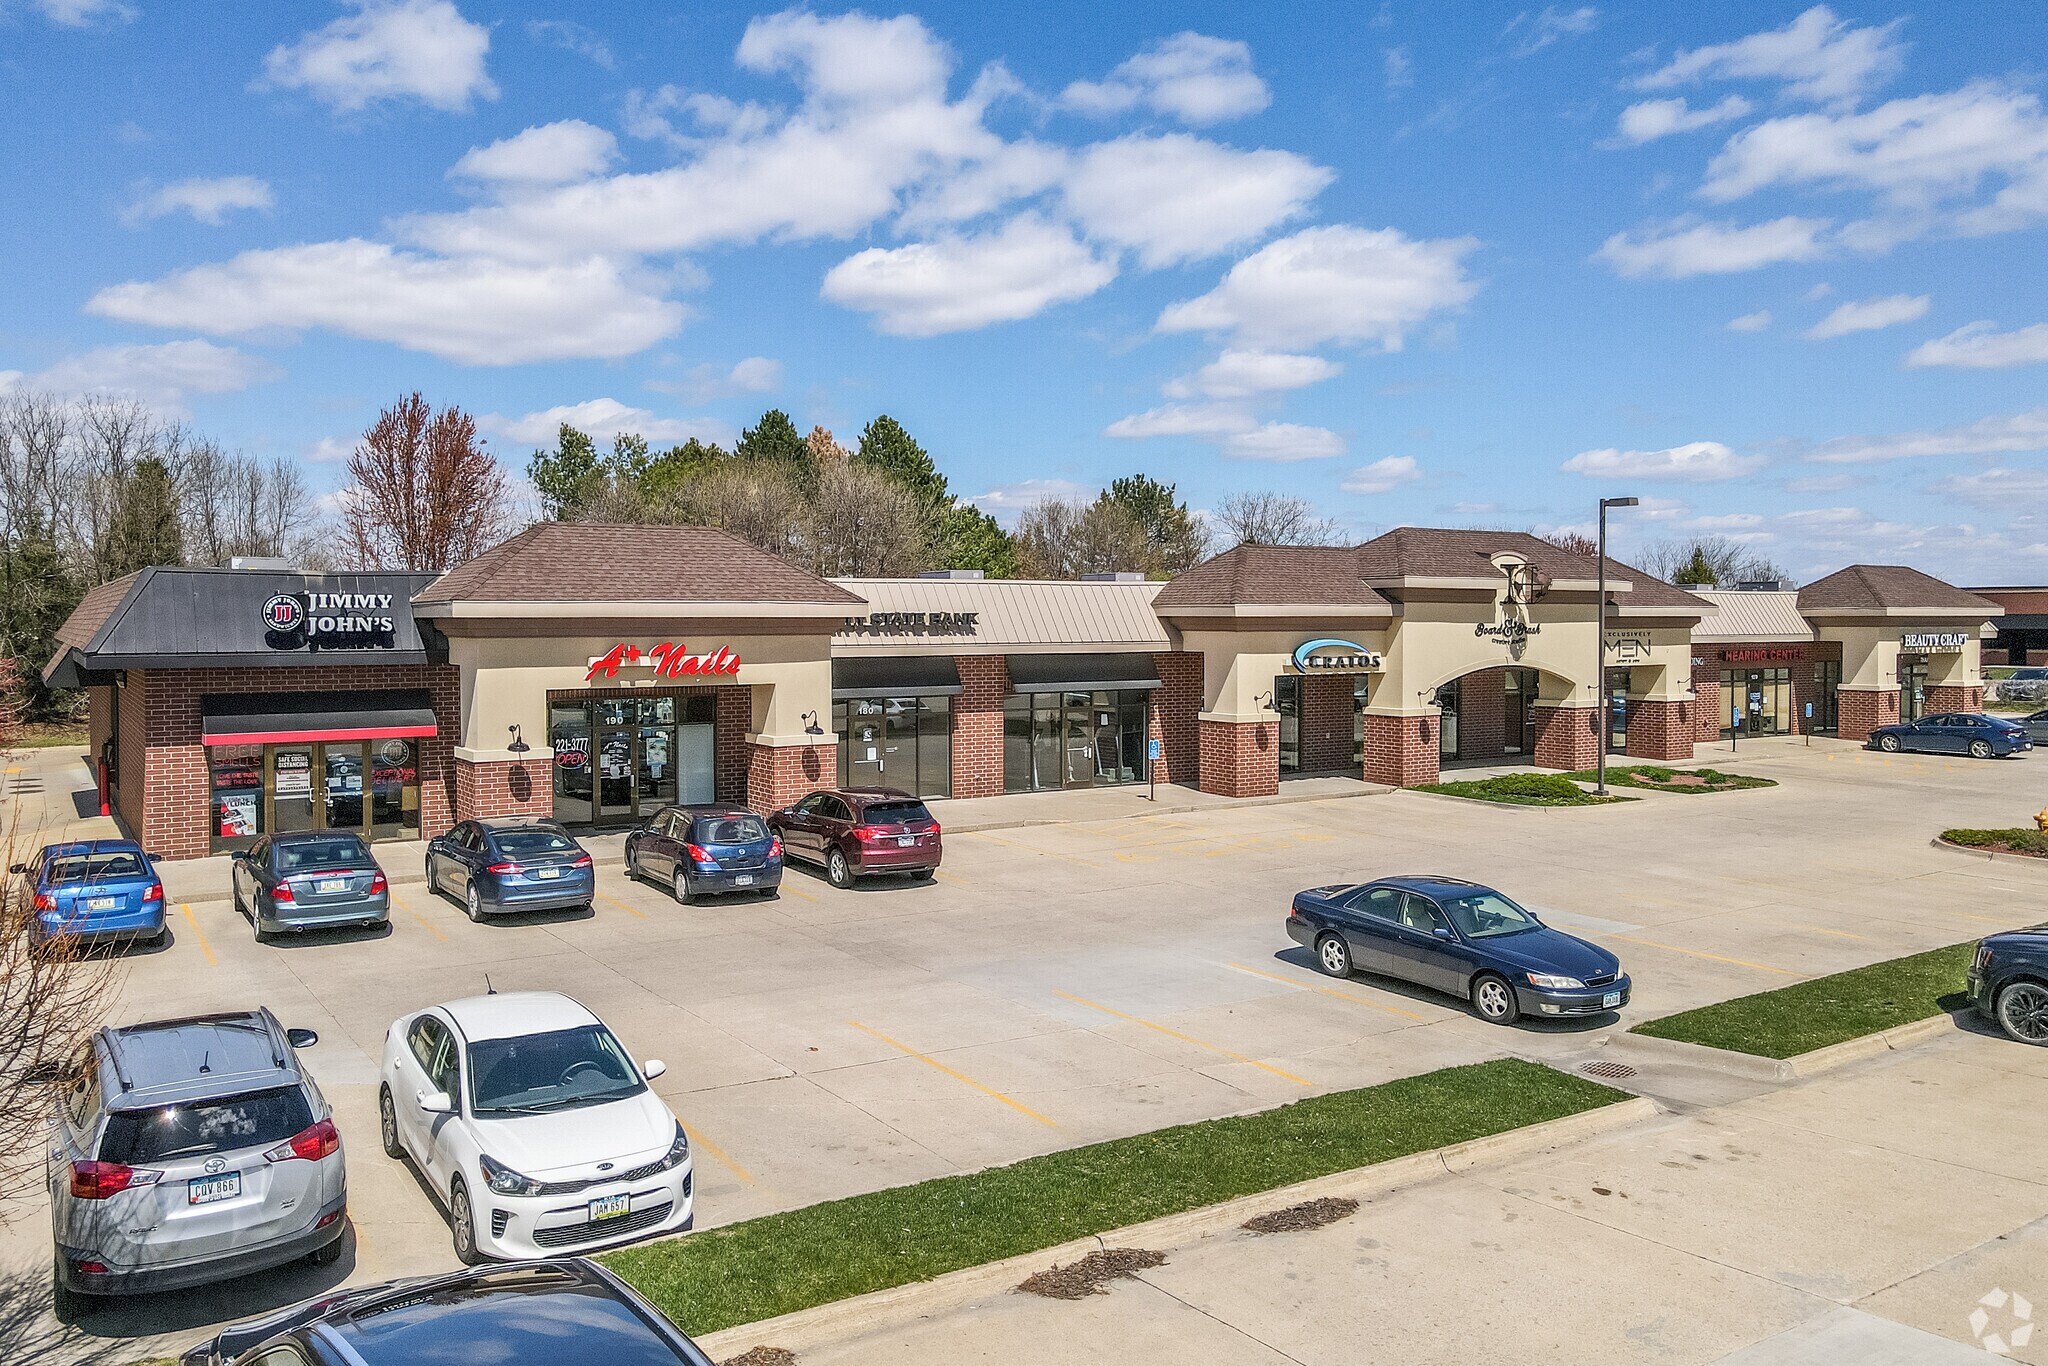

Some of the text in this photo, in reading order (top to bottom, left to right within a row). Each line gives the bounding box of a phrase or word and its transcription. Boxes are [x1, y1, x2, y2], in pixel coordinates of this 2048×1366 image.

[308, 593, 393, 613] JIMMY
[274, 604, 292, 622] JJ
[869, 612, 926, 626] STATE
[928, 612, 980, 625] BANK
[308, 616, 393, 636] JOHN'S
[1475, 622, 1503, 637] Board
[1904, 633, 1969, 647] BEAUTY CRAFT
[1603, 639, 1651, 658] MEN
[1725, 648, 1804, 662] HEARING CENTER
[584, 641, 740, 681] A+ Nails
[1308, 655, 1381, 669] CRATOS
[858, 707, 874, 715] 180
[604, 717, 624, 725] 190
[213, 744, 260, 759] FREE
[555, 738, 589, 752] 221-3777
[213, 757, 261, 768] SMELLS
[555, 752, 586, 765] OPEN
[216, 1178, 235, 1194] 866
[594, 1199, 625, 1216] JAM 657
